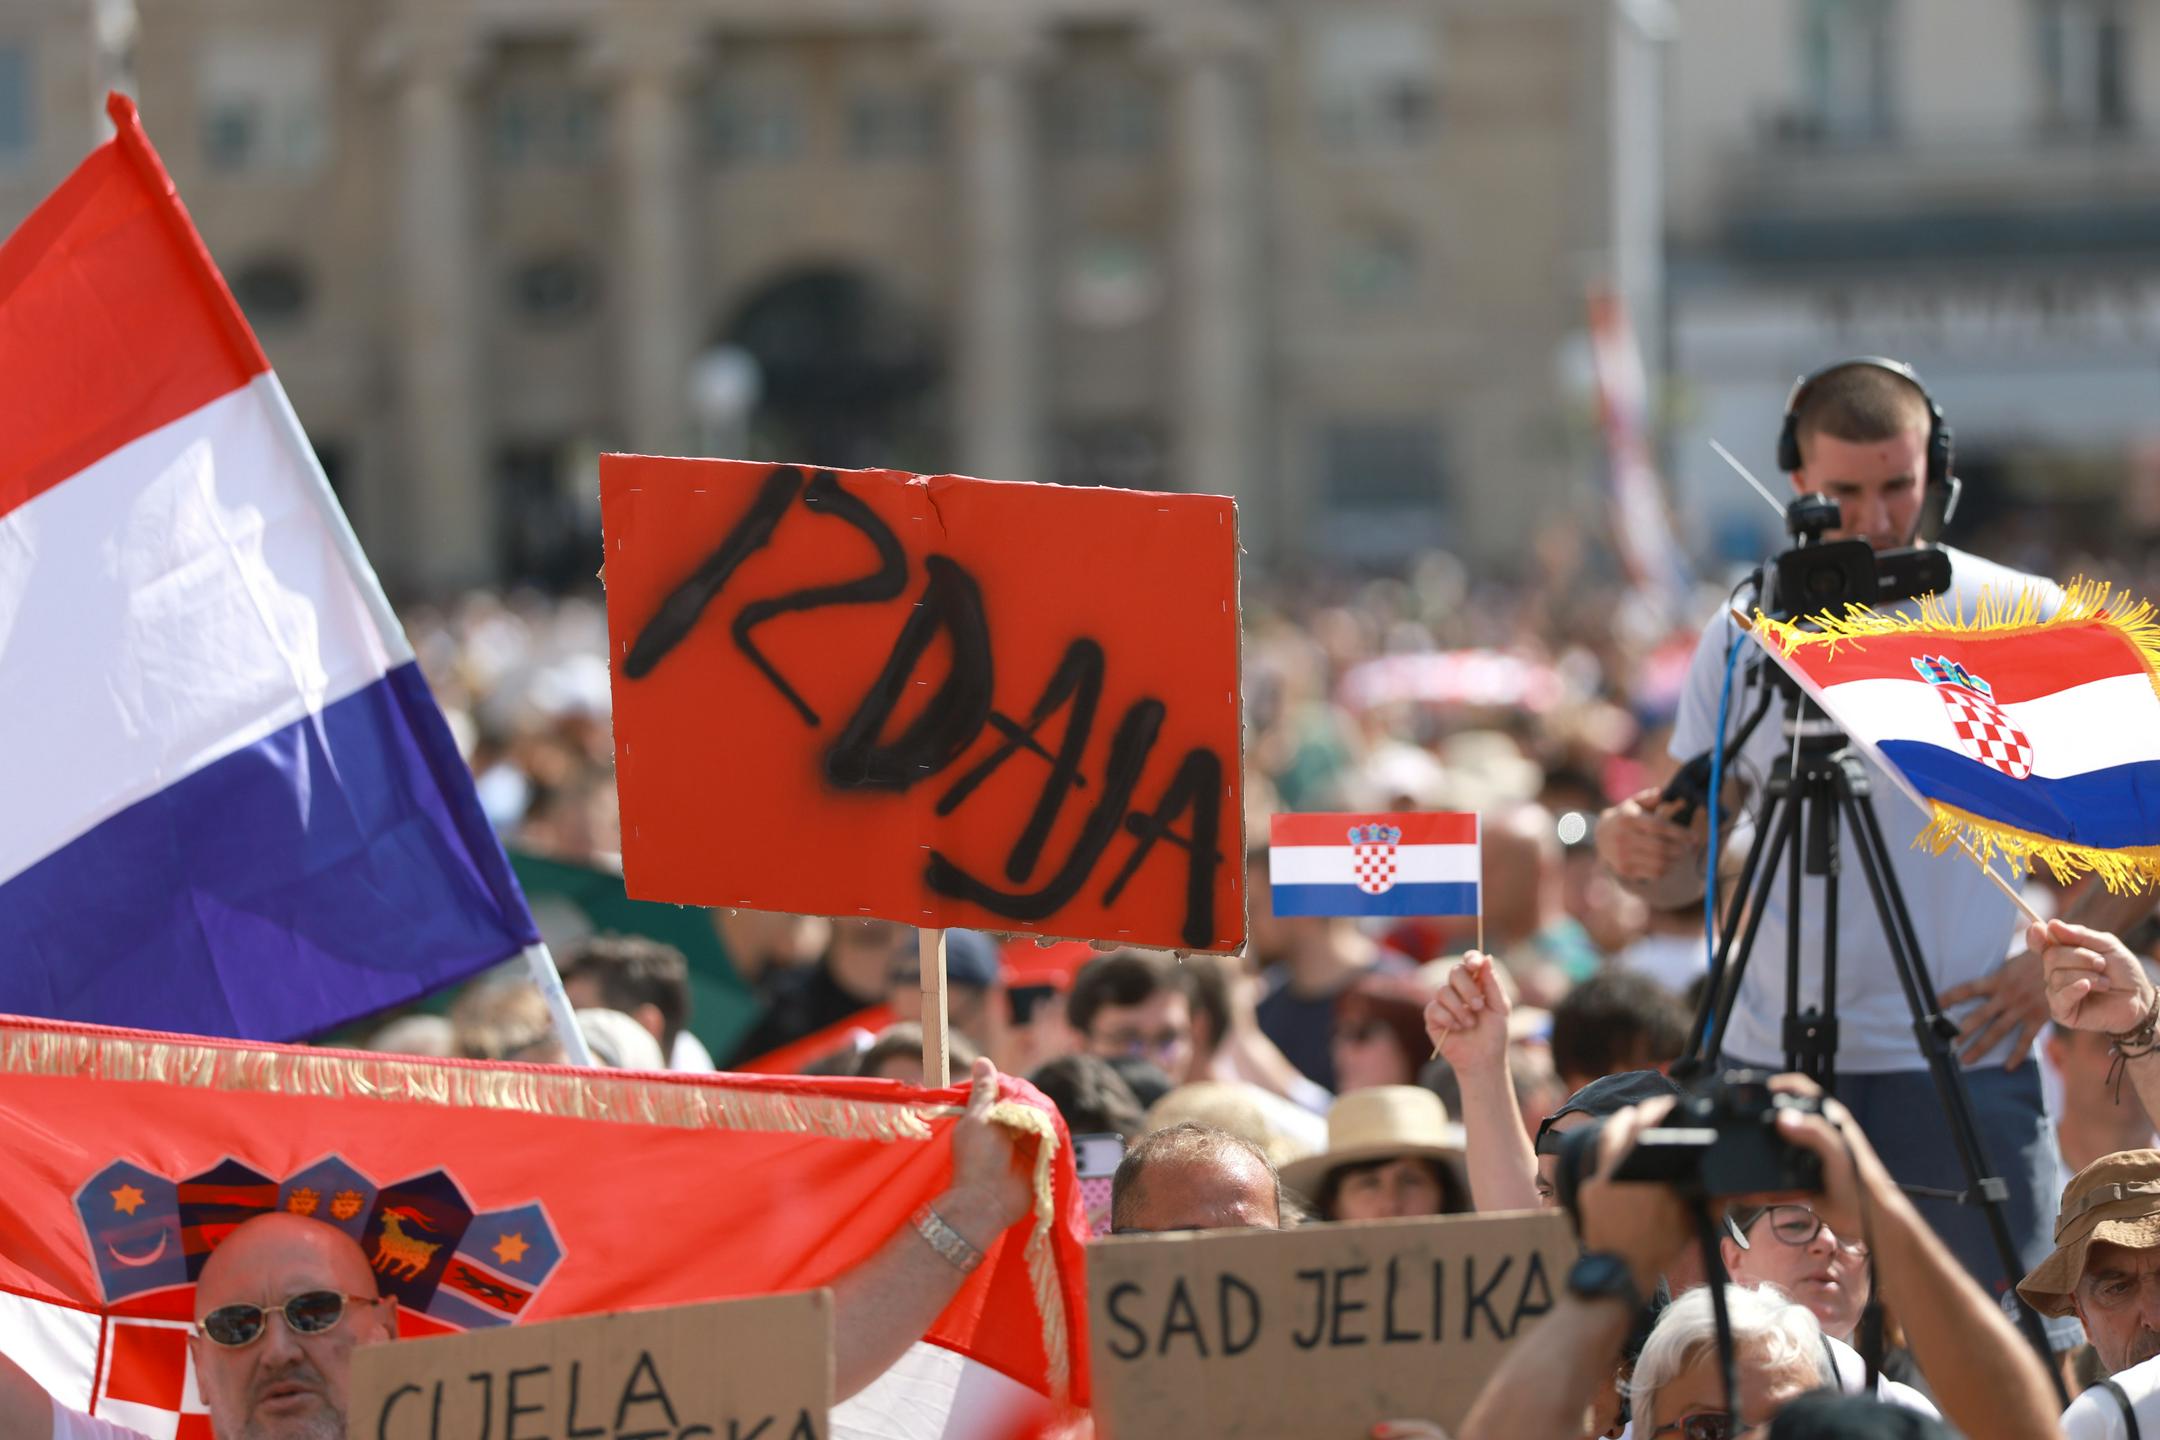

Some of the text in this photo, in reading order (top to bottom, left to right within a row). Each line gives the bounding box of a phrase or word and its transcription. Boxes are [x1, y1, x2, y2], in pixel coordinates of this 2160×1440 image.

[1106, 1249, 1555, 1361] SAD JELIKA
[377, 1351, 679, 1440] CIJELA
